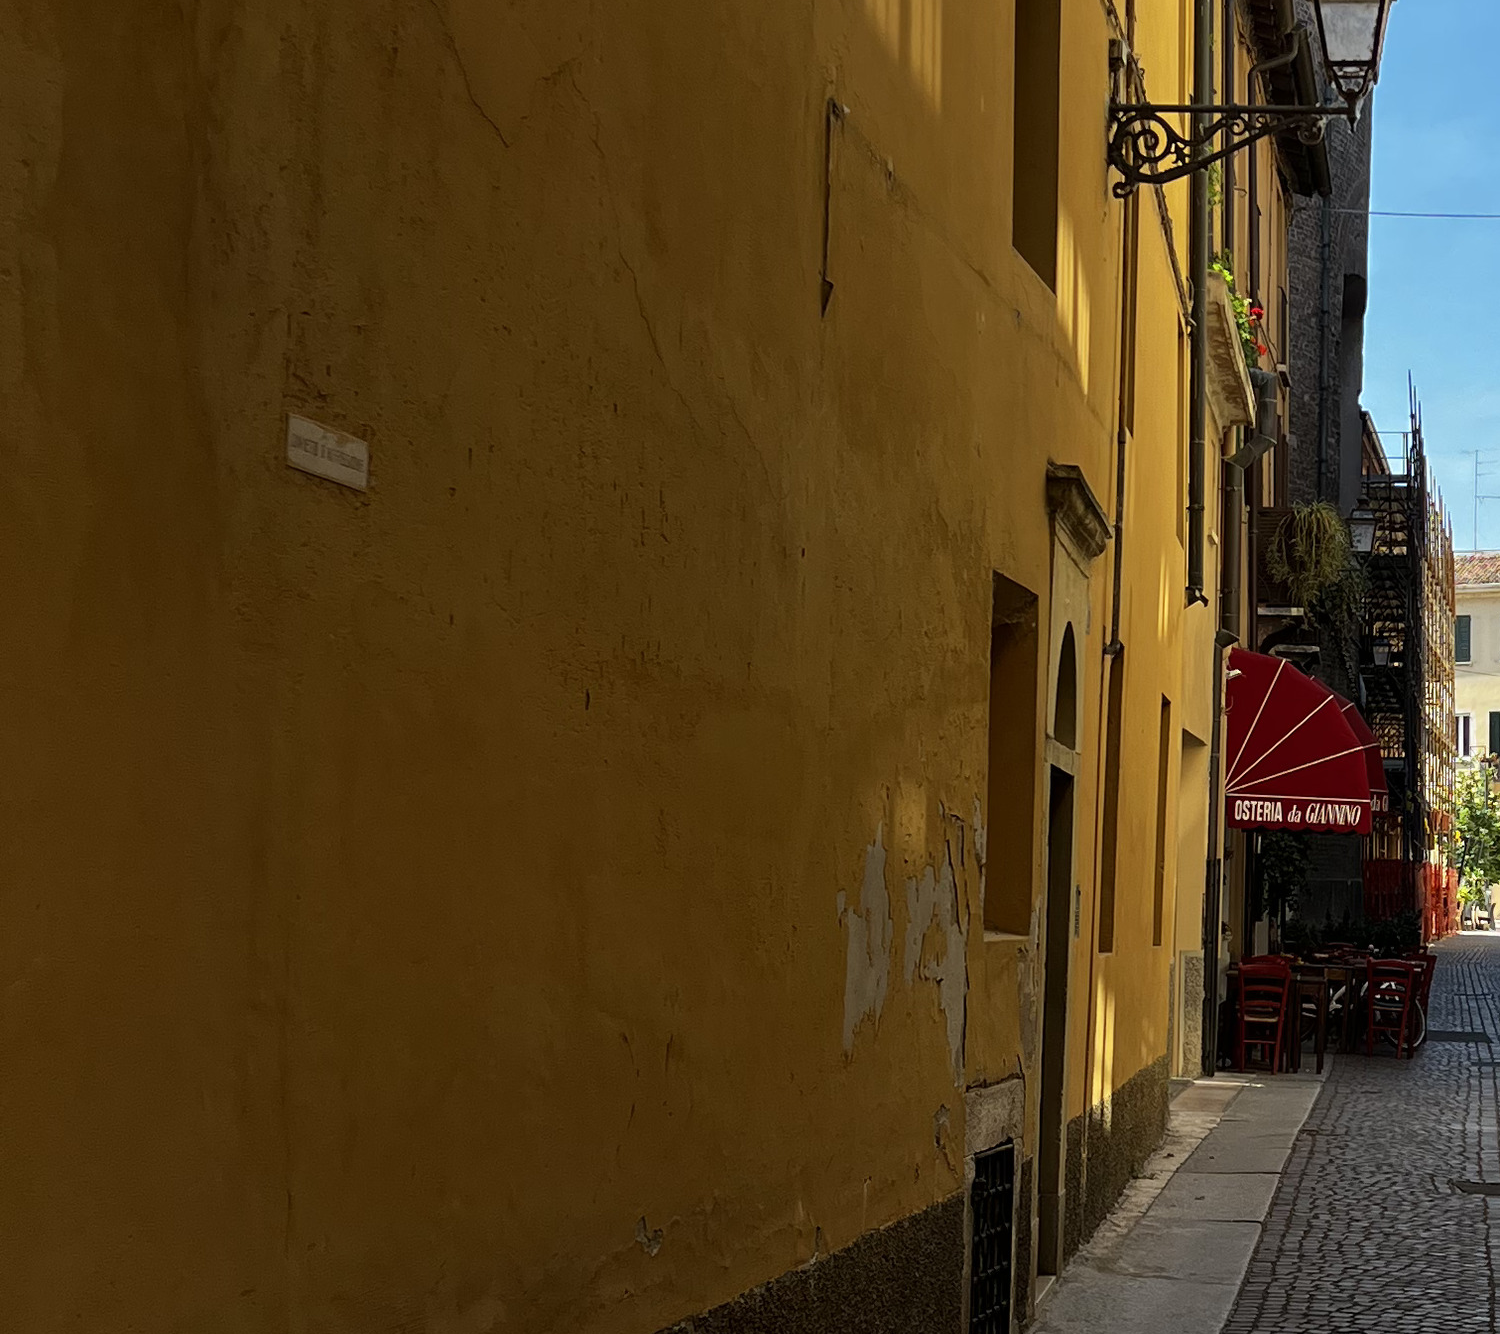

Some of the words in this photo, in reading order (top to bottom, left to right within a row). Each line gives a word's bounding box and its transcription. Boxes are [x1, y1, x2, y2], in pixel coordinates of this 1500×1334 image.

[1234, 799, 1283, 823] OSTERIA
[1287, 805, 1302, 823] da
[1305, 803, 1361, 826] GIANNINO
